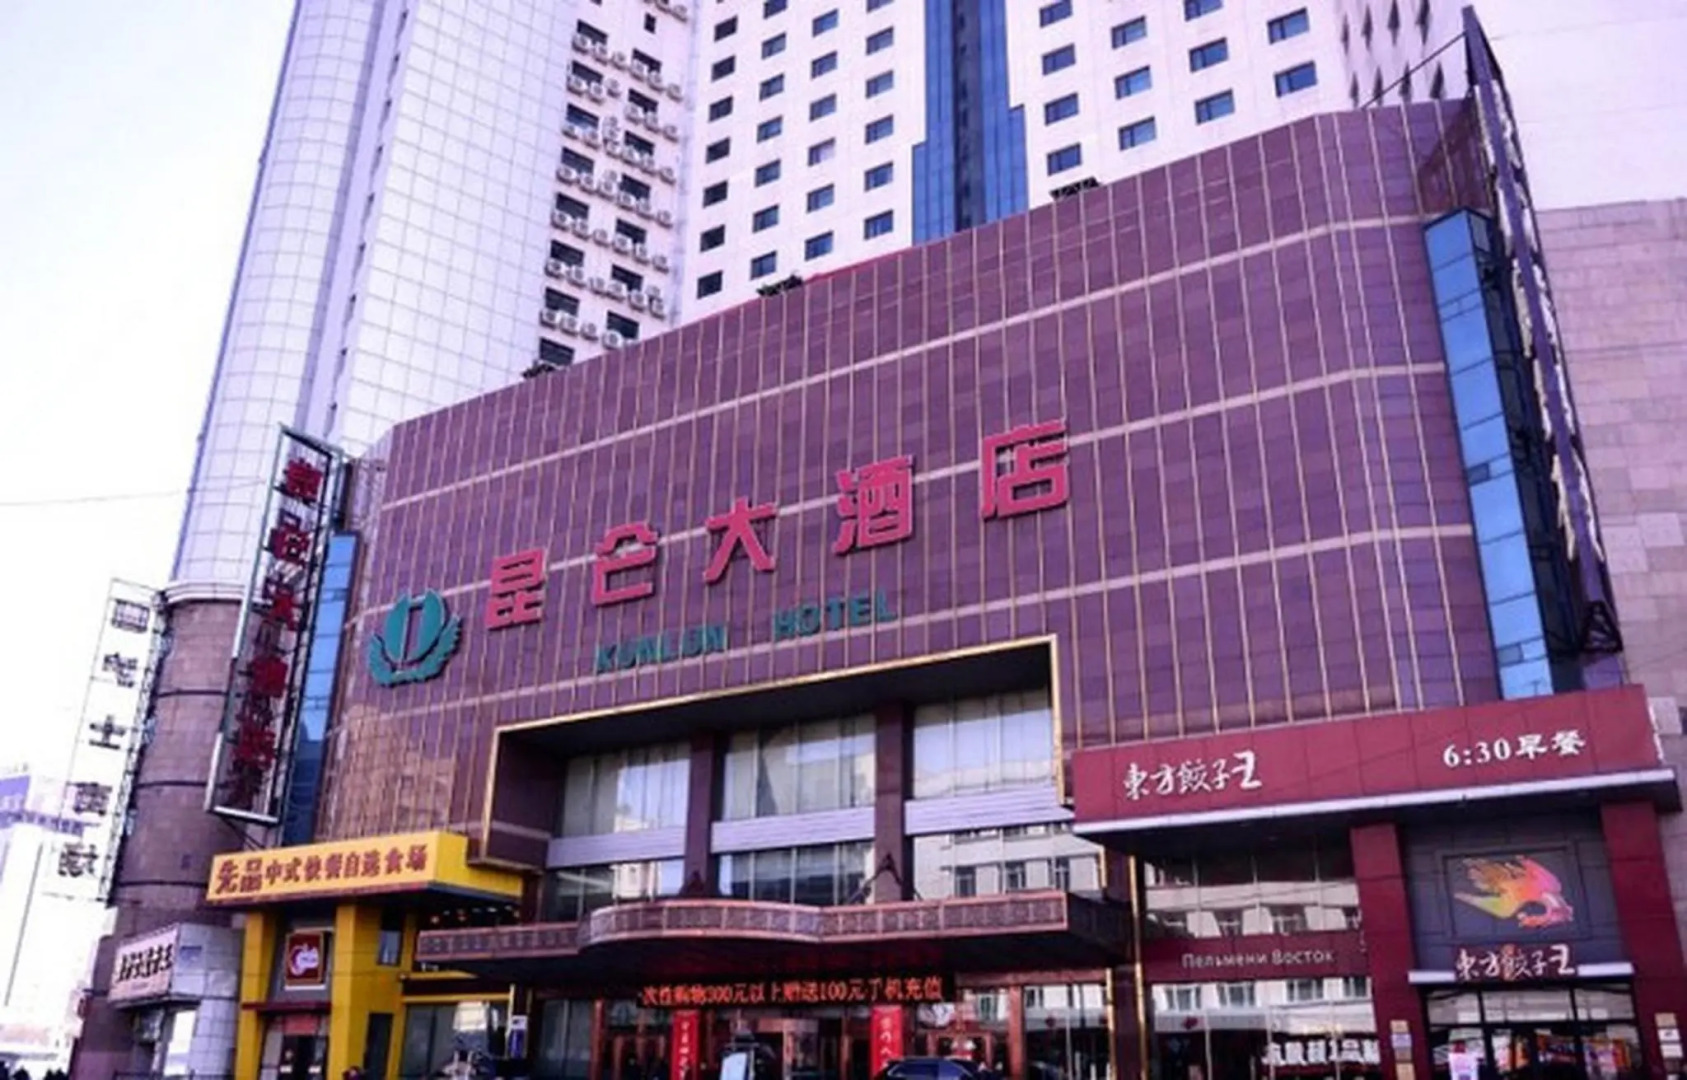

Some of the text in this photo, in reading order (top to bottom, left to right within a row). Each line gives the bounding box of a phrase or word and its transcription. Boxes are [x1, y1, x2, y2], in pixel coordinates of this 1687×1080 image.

[485, 418, 1071, 630] 昆仑大酒店
[594, 589, 897, 675] KUNLUN HOTEL
[1442, 729, 1587, 768] 6:30早餐
[1181, 948, 1335, 969] Пельмени Восток
